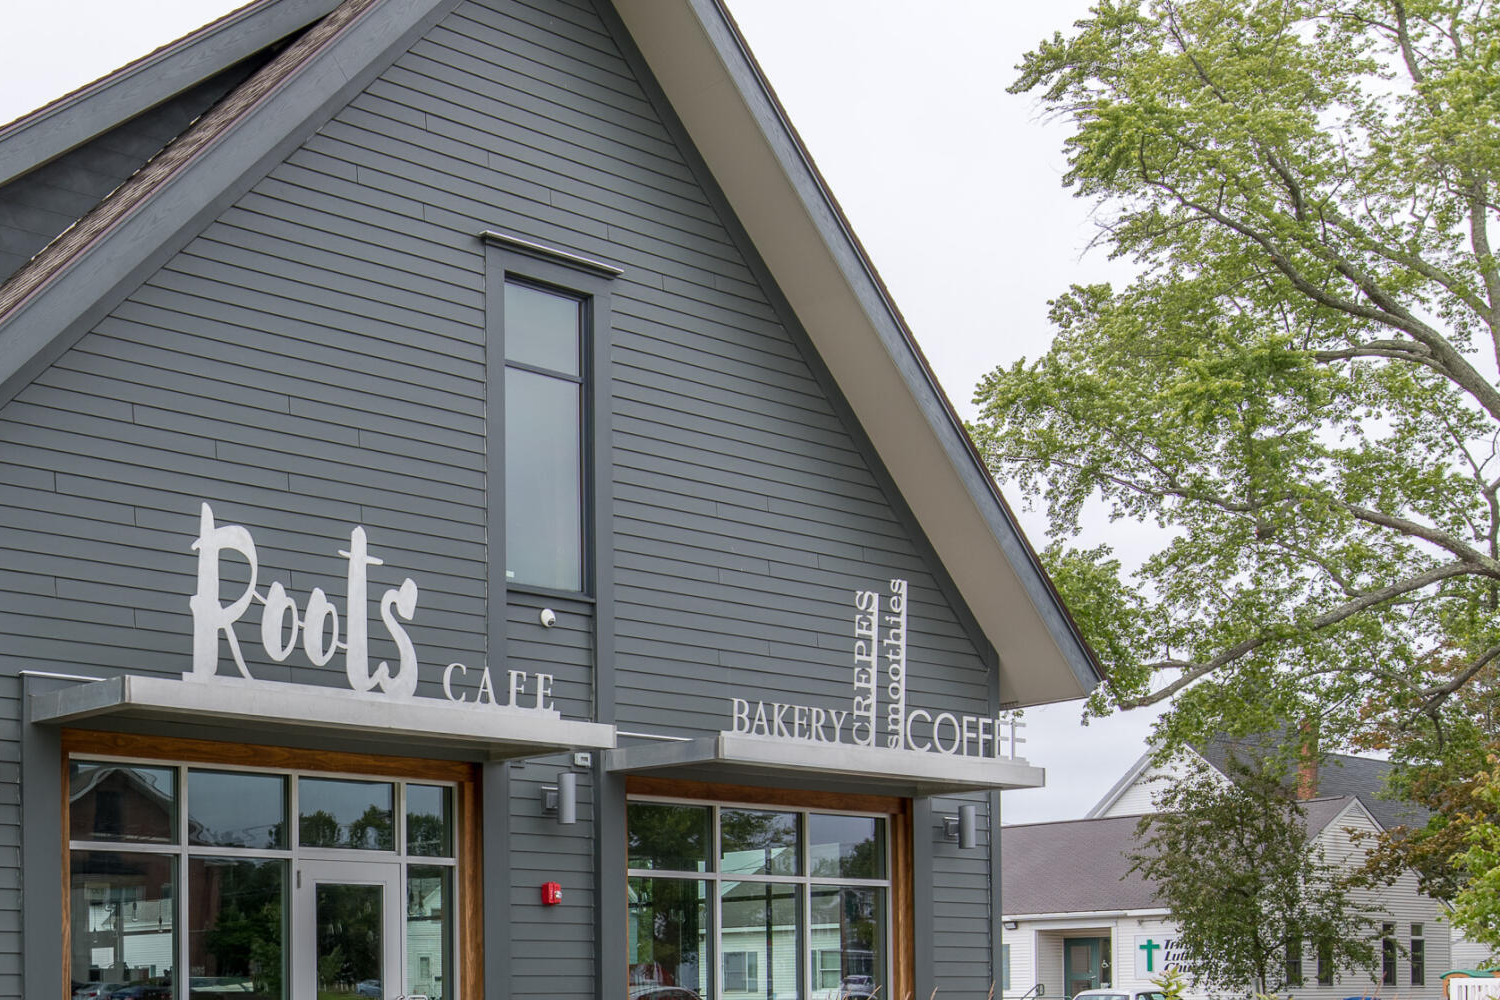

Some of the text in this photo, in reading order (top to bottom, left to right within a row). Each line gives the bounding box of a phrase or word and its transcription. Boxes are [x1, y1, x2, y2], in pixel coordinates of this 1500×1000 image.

[182, 502, 418, 698] Roots
[443, 663, 555, 712] CAFE
[852, 590, 875, 747] CREPES
[883, 578, 904, 750] smoothies
[731, 697, 850, 746] BAKERY
[906, 709, 1027, 761] COFFEE
